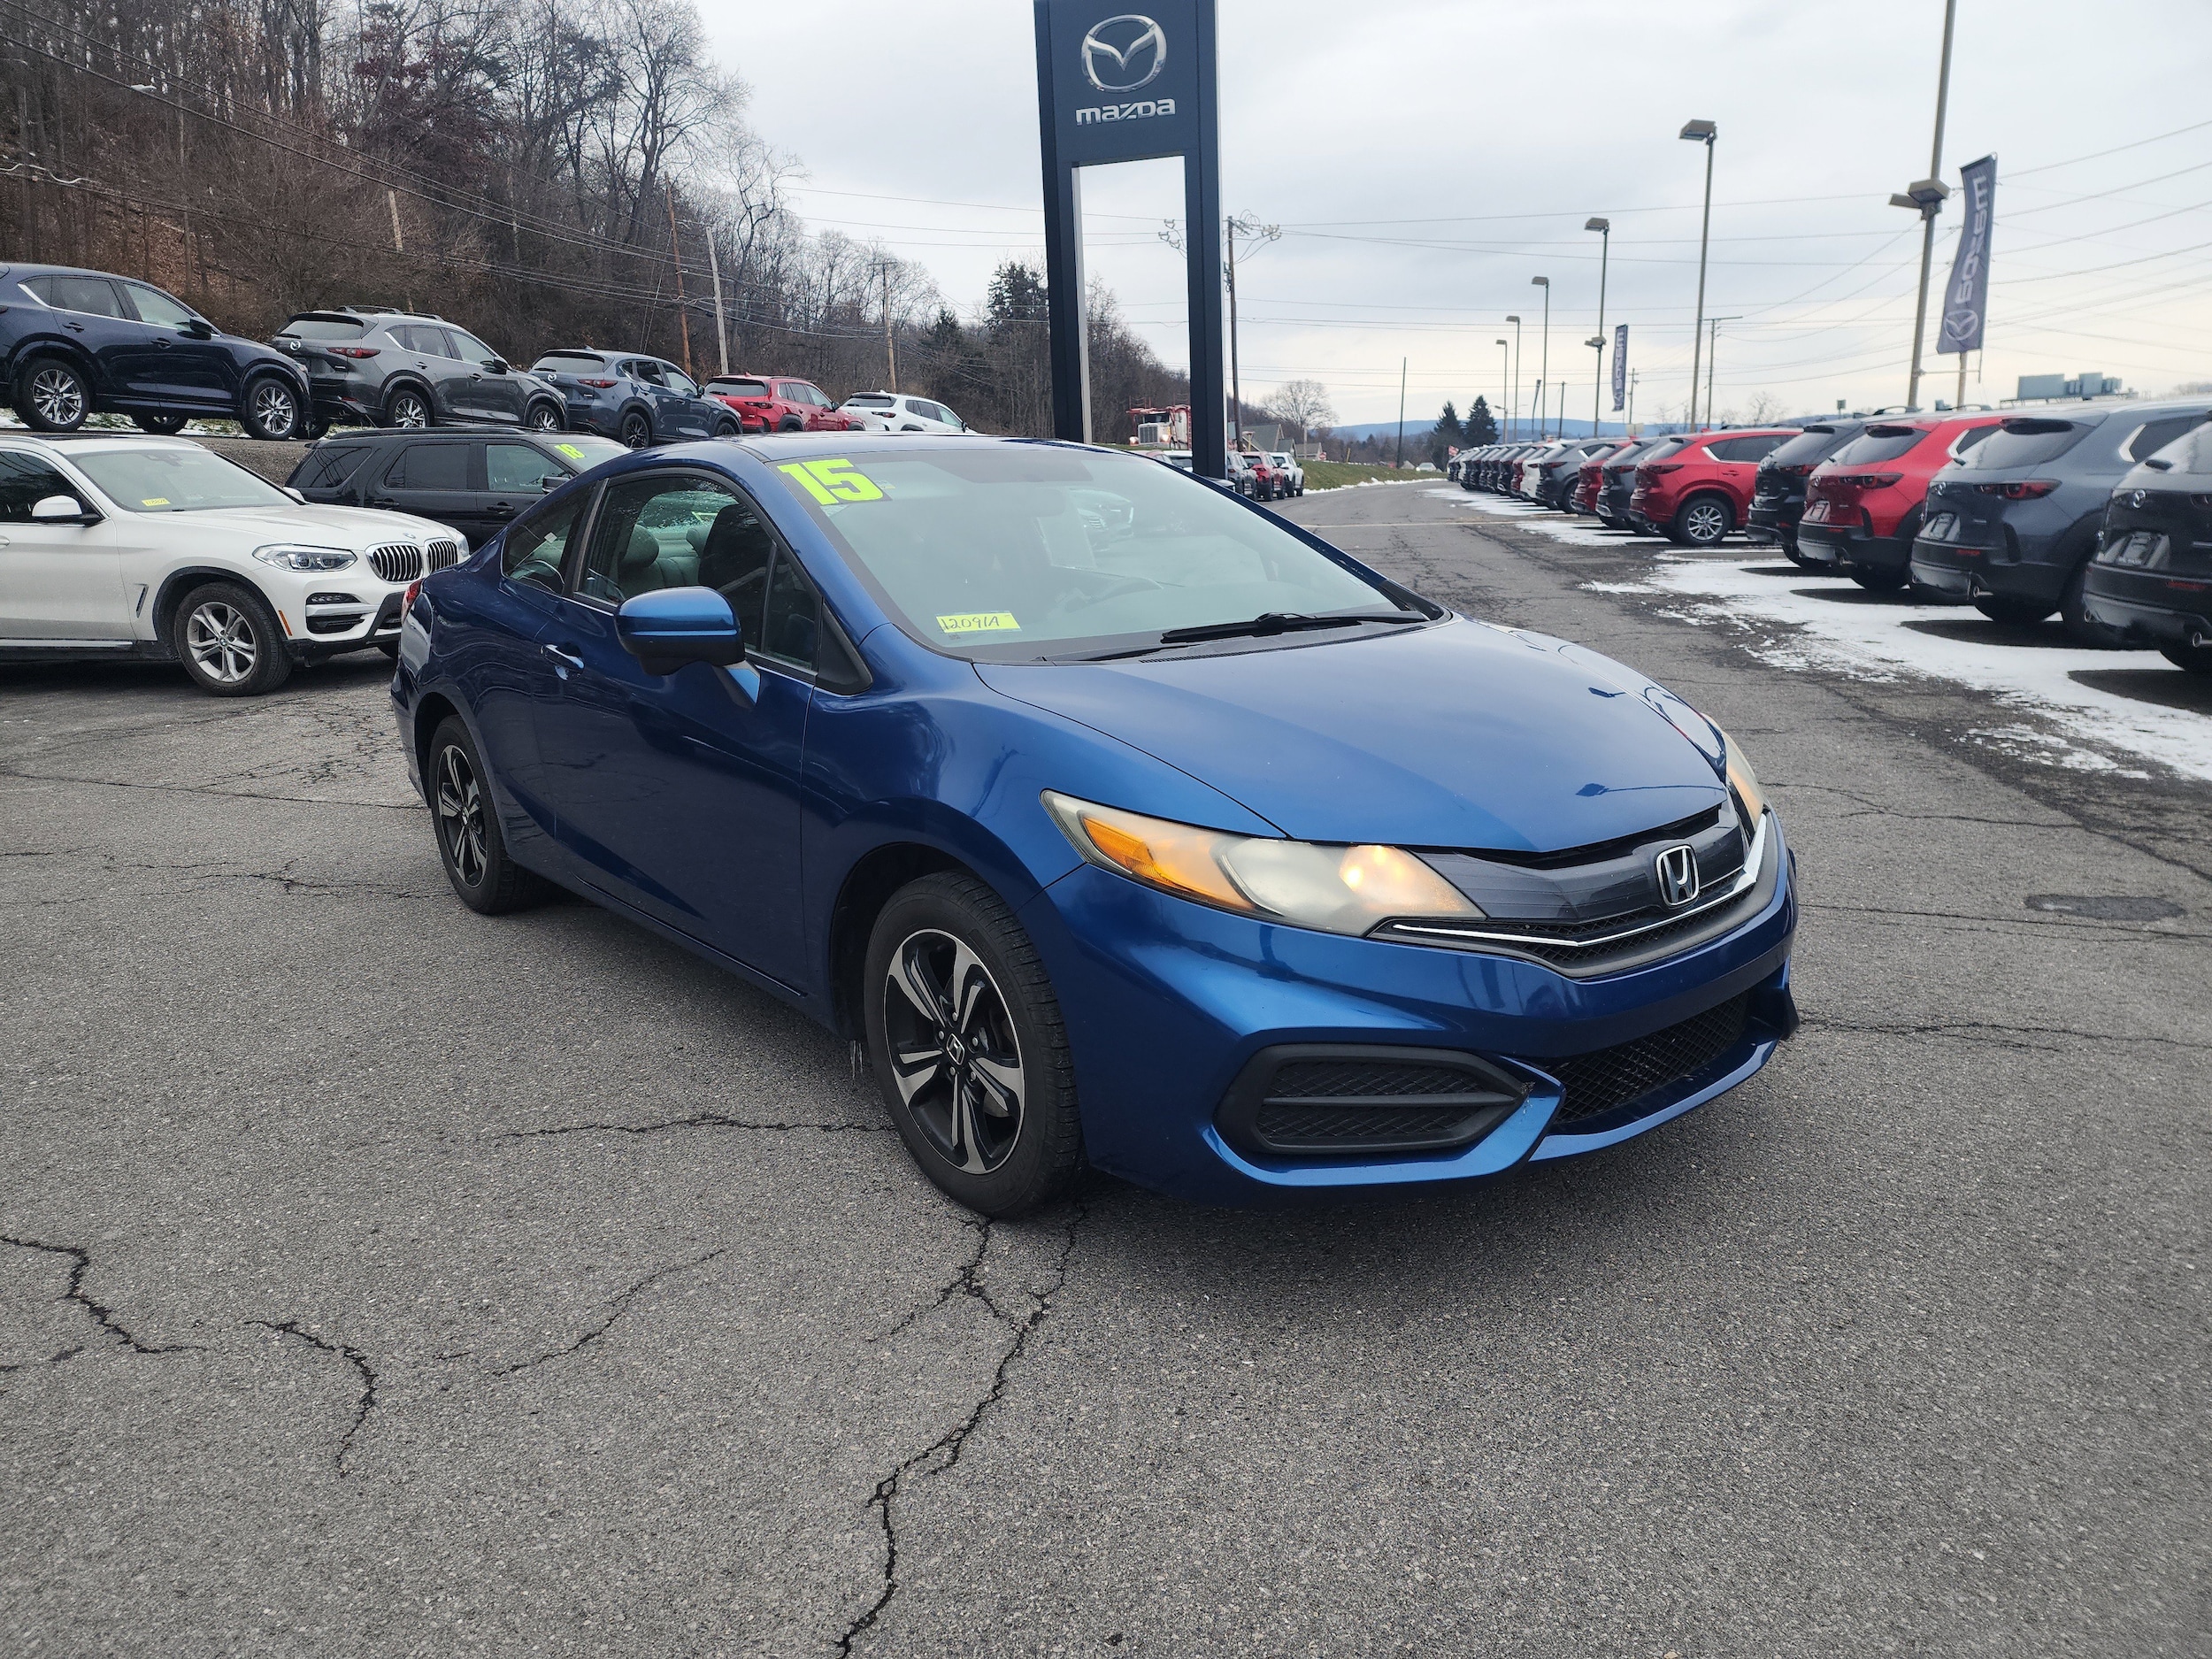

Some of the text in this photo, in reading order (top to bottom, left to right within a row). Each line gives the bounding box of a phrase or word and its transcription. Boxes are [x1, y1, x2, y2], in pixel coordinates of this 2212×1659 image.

[1075, 98, 1176, 127] mazda
[777, 458, 883, 505] 15
[941, 616, 1000, 630] 12091A
